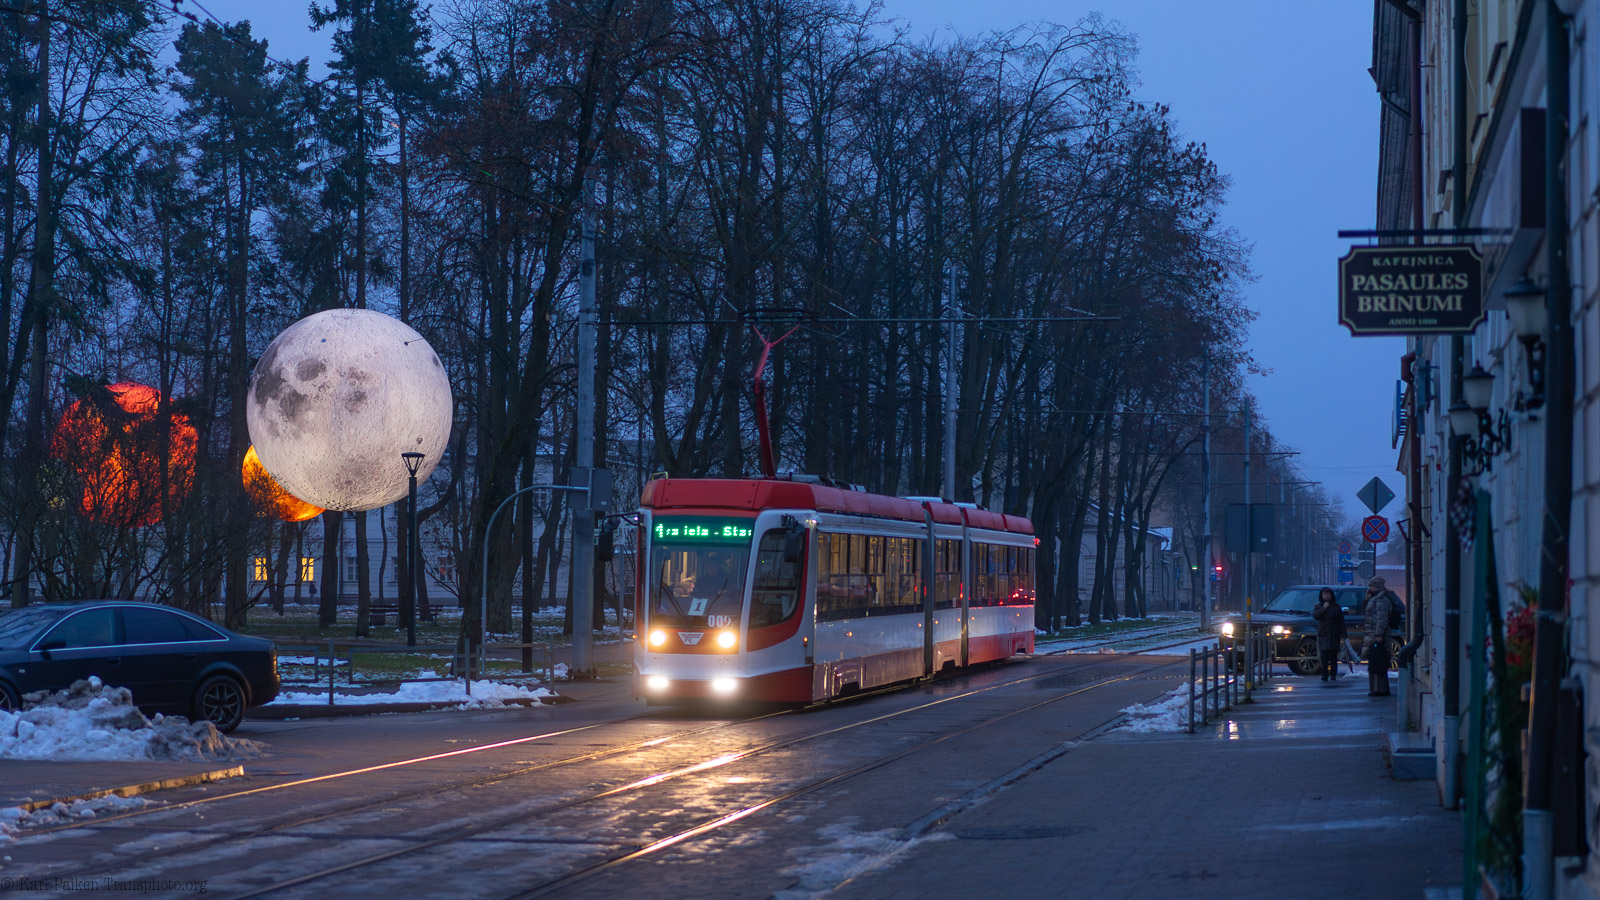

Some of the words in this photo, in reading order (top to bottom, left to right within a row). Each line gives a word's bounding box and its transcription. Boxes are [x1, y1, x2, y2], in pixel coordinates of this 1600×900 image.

[1351, 273, 1469, 291] PASAULES
[1357, 293, 1463, 312] BRĪNUMI
[693, 602, 702, 612] 1
[707, 614, 732, 628] 009
